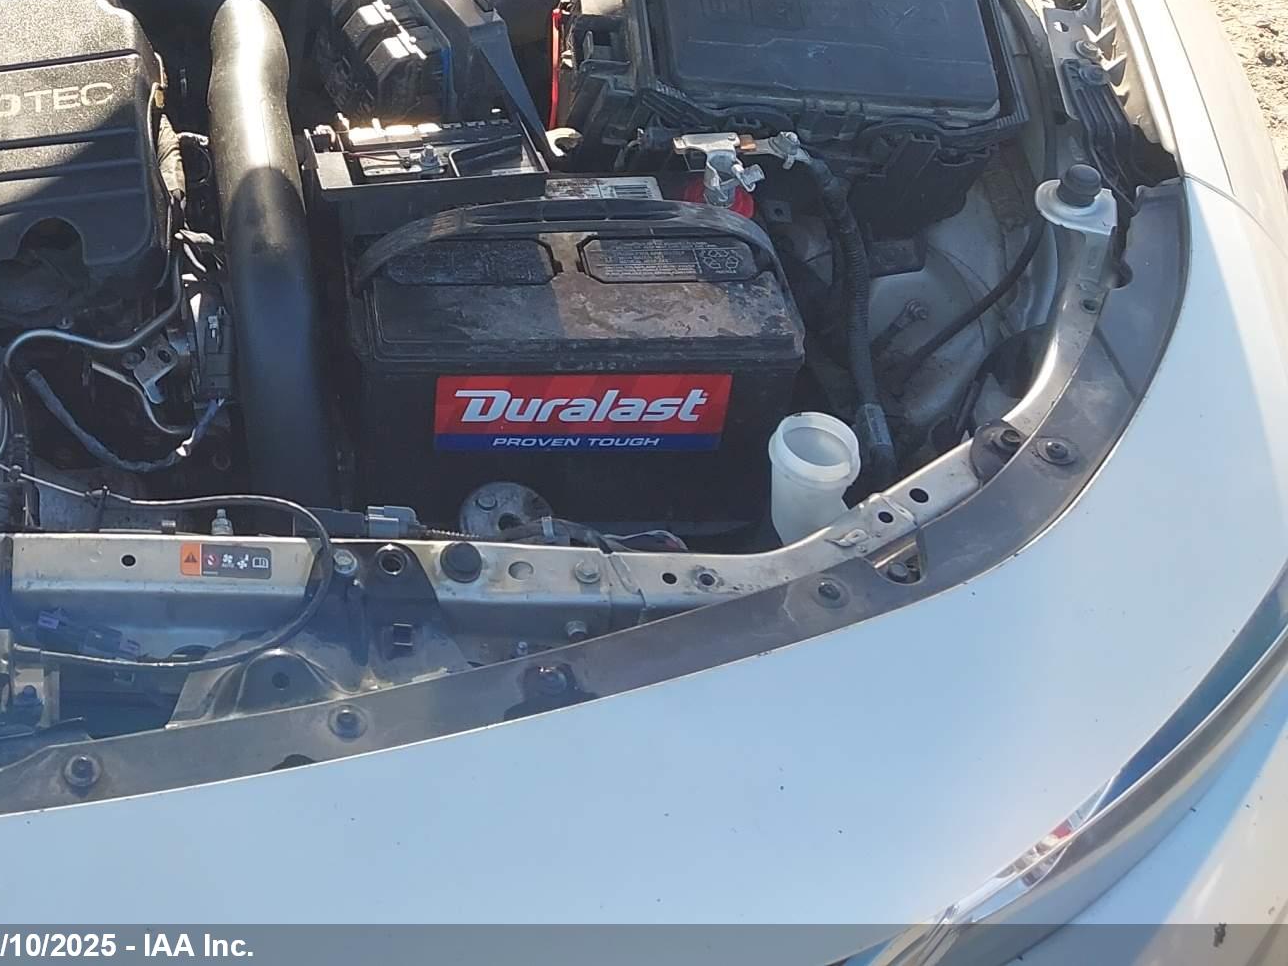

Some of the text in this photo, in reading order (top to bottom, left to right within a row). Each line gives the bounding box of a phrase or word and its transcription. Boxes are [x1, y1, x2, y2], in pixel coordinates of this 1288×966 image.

[455, 389, 707, 422] Duralast
[492, 437, 660, 447] PROVEN TOUGH
